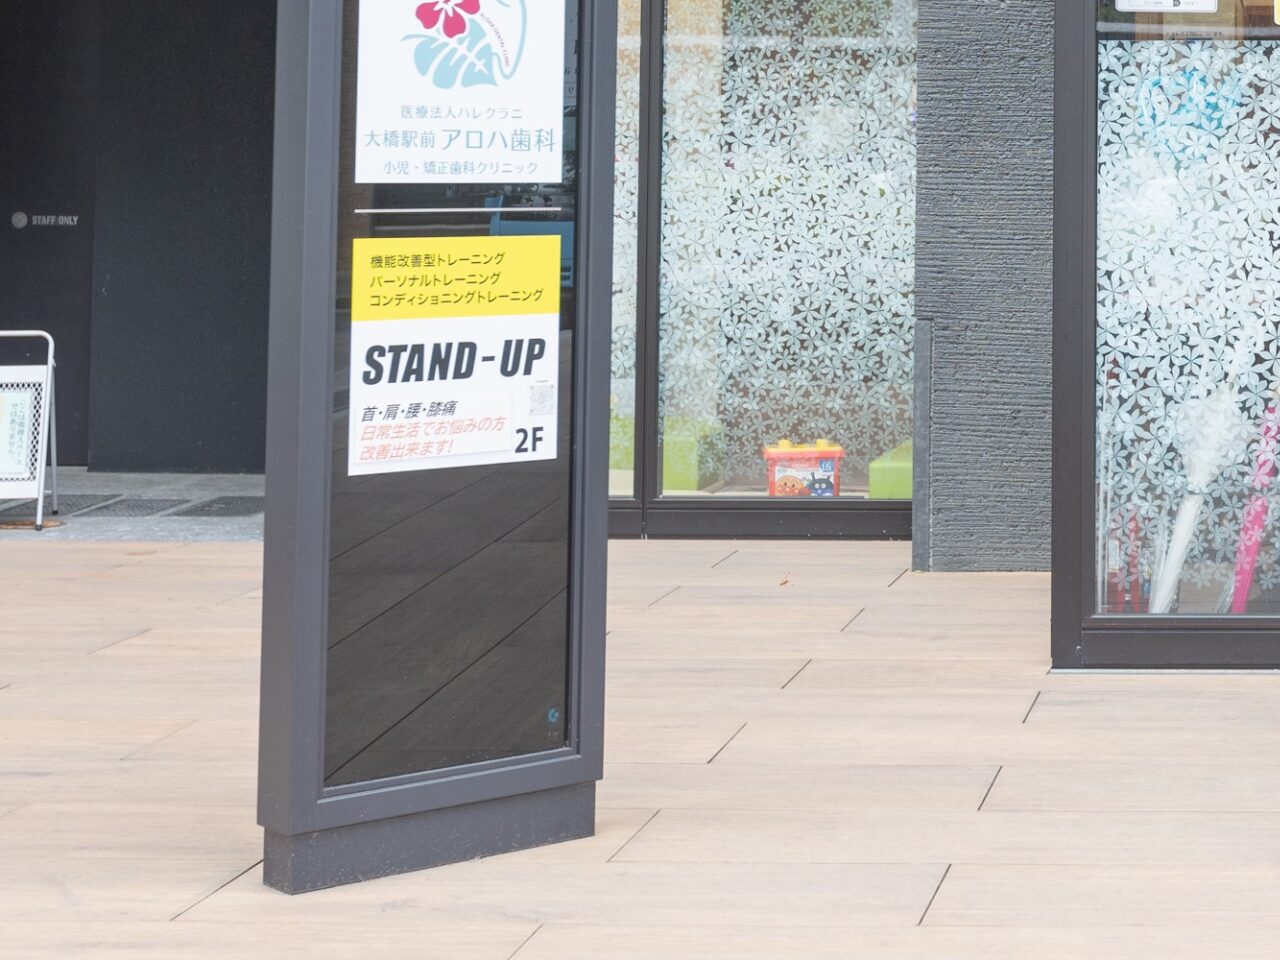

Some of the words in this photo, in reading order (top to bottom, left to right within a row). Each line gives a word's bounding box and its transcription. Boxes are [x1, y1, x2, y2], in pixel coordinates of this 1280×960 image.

[400, 104, 523, 120] 医療法人ハレクラニ
[383, 159, 538, 176] 小児・矯正歯科クリニック
[32, 215, 56, 225] STAFF
[58, 215, 78, 225] ONLY
[370, 252, 506, 269] 機能改善型トレーニング
[370, 271, 501, 289] パーソナルトレーニング
[370, 289, 545, 307] コンディショニングトレーニング
[362, 338, 546, 386] STAND-UP
[361, 400, 458, 422] 首・肩・腰・膝痛
[360, 415, 507, 441] 日常生活でお悩みの方
[515, 426, 544, 453] 2F
